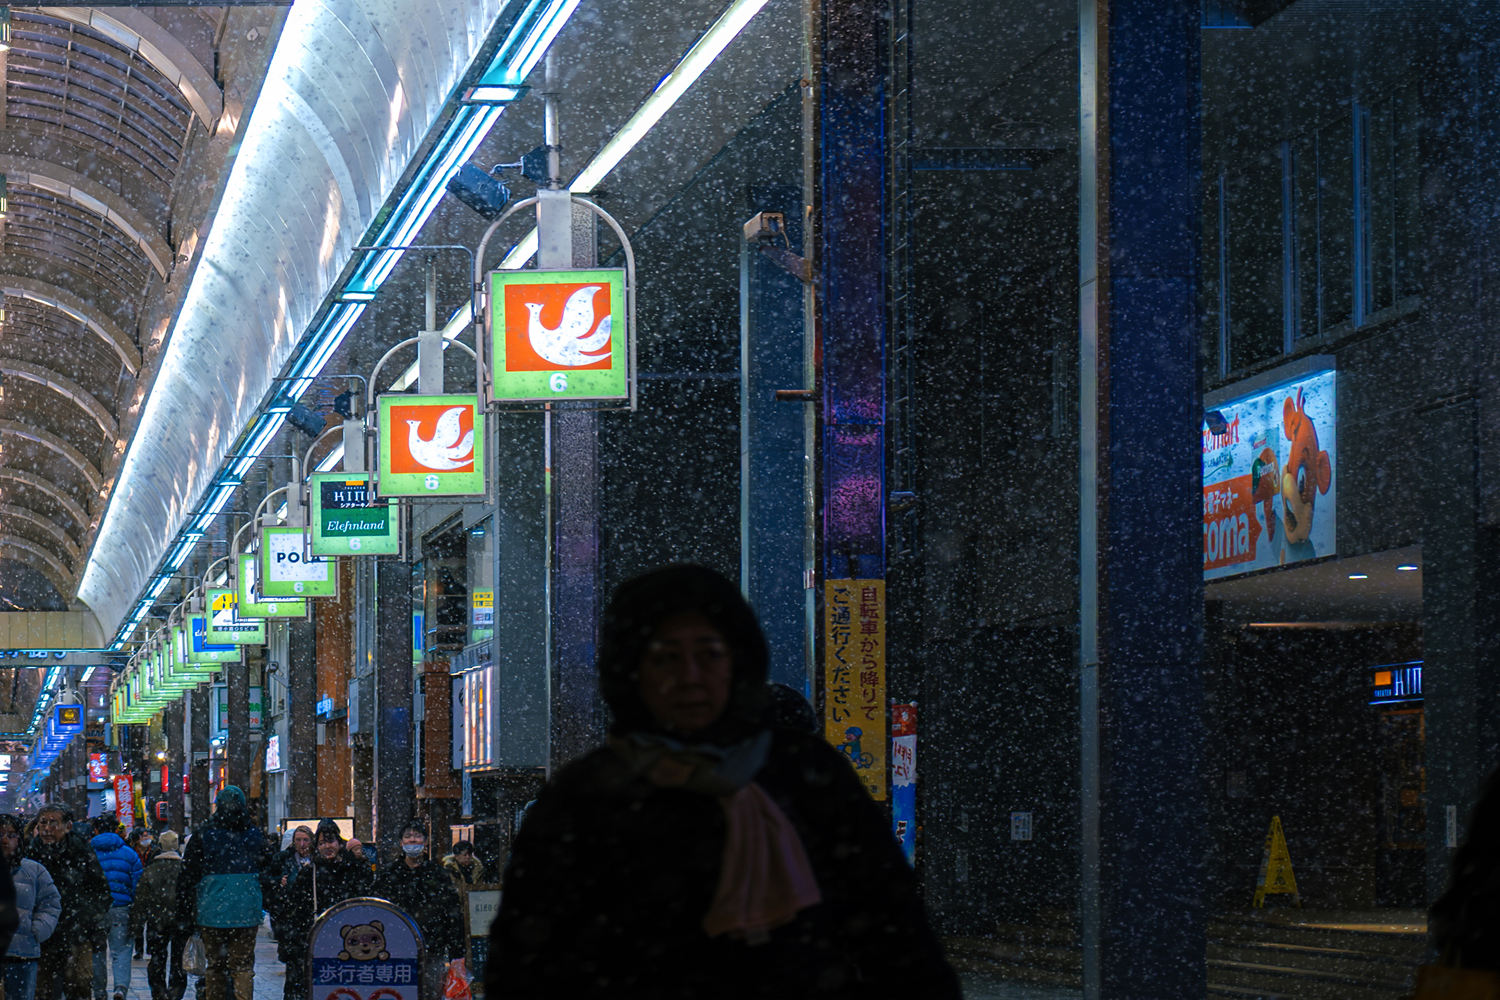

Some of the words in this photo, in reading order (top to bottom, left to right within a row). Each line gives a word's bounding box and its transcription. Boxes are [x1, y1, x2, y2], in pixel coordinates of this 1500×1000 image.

[549, 372, 568, 393] 6
[424, 474, 440, 490] 6
[327, 520, 385, 533] Elefinland
[349, 537, 362, 550] 6
[293, 582, 304, 593] 6
[268, 603, 278, 614] 6
[231, 632, 240, 642] 6
[831, 588, 851, 723] ご通行ください
[860, 587, 880, 721] 自転車から降りて
[319, 963, 412, 983] 歩行者専用
